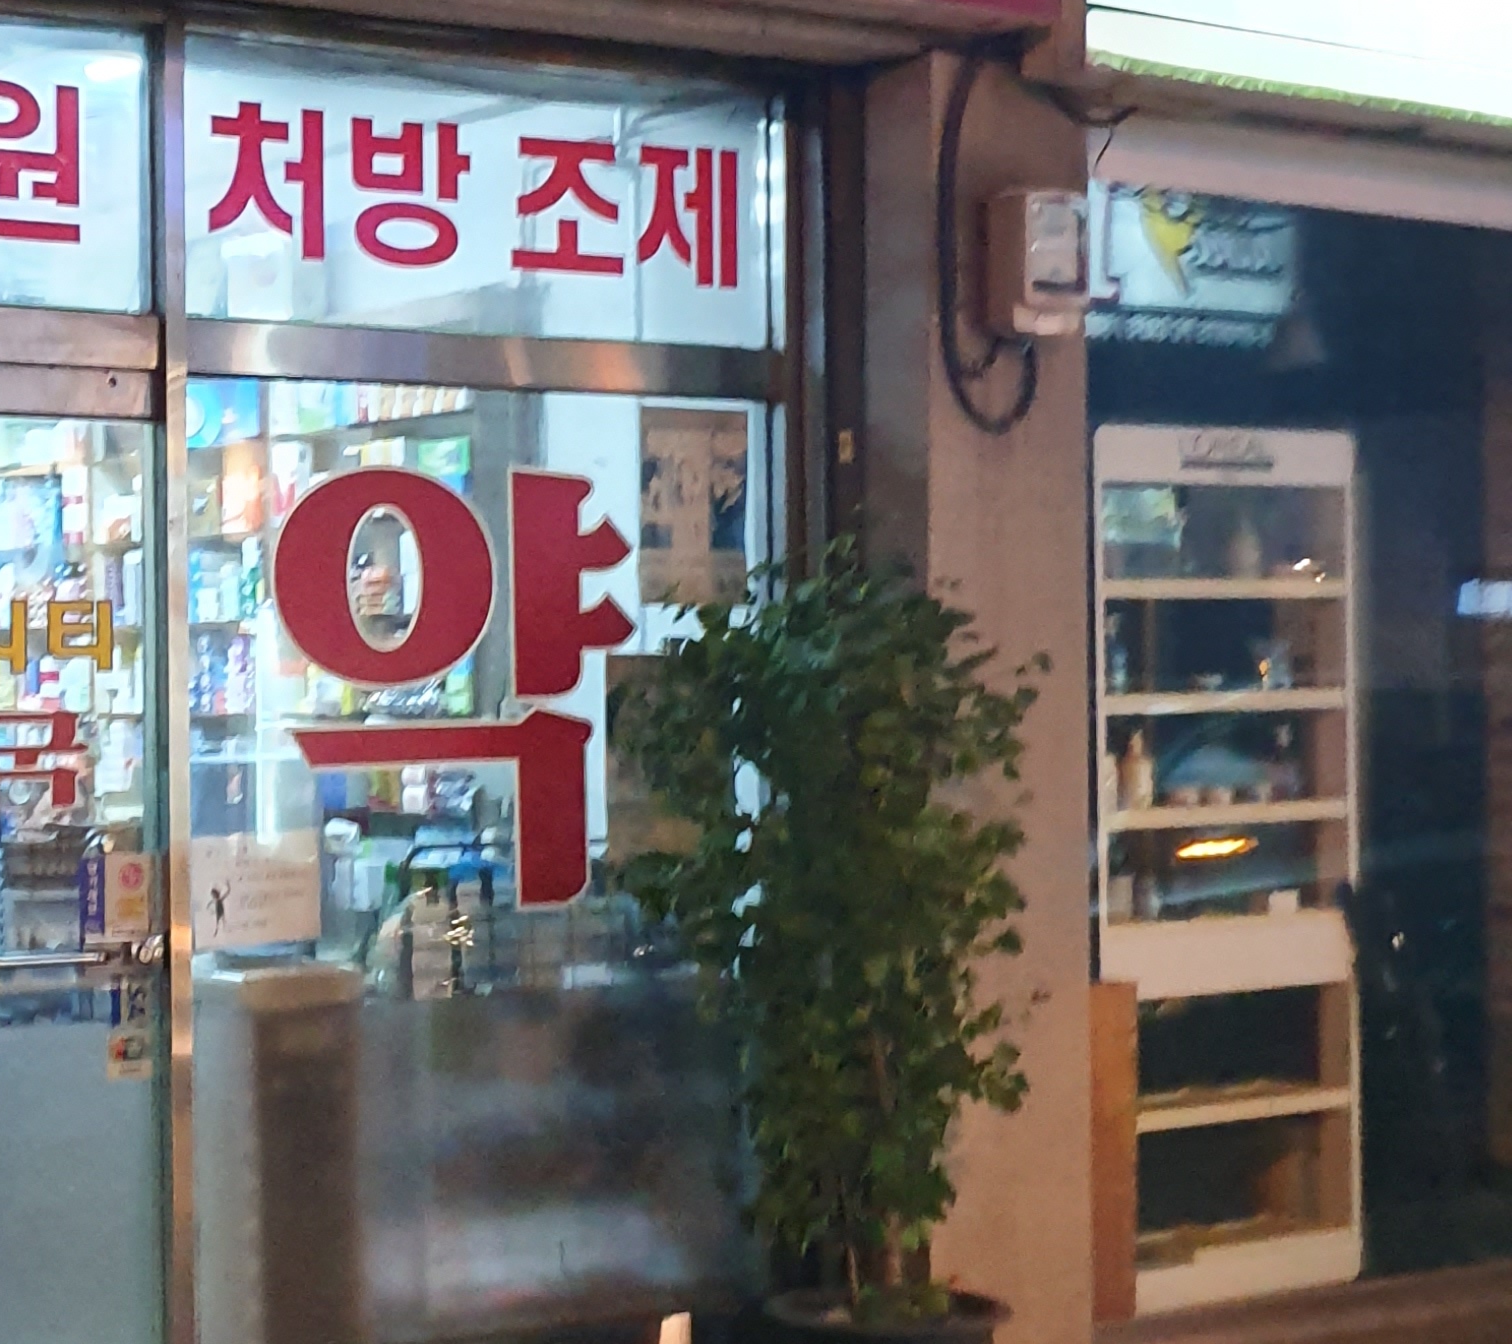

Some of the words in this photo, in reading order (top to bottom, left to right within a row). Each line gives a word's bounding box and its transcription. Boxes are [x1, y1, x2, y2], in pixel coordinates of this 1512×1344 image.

[208, 101, 470, 267] 처방
[511, 136, 738, 289] 조제
[274, 467, 637, 909] 약
